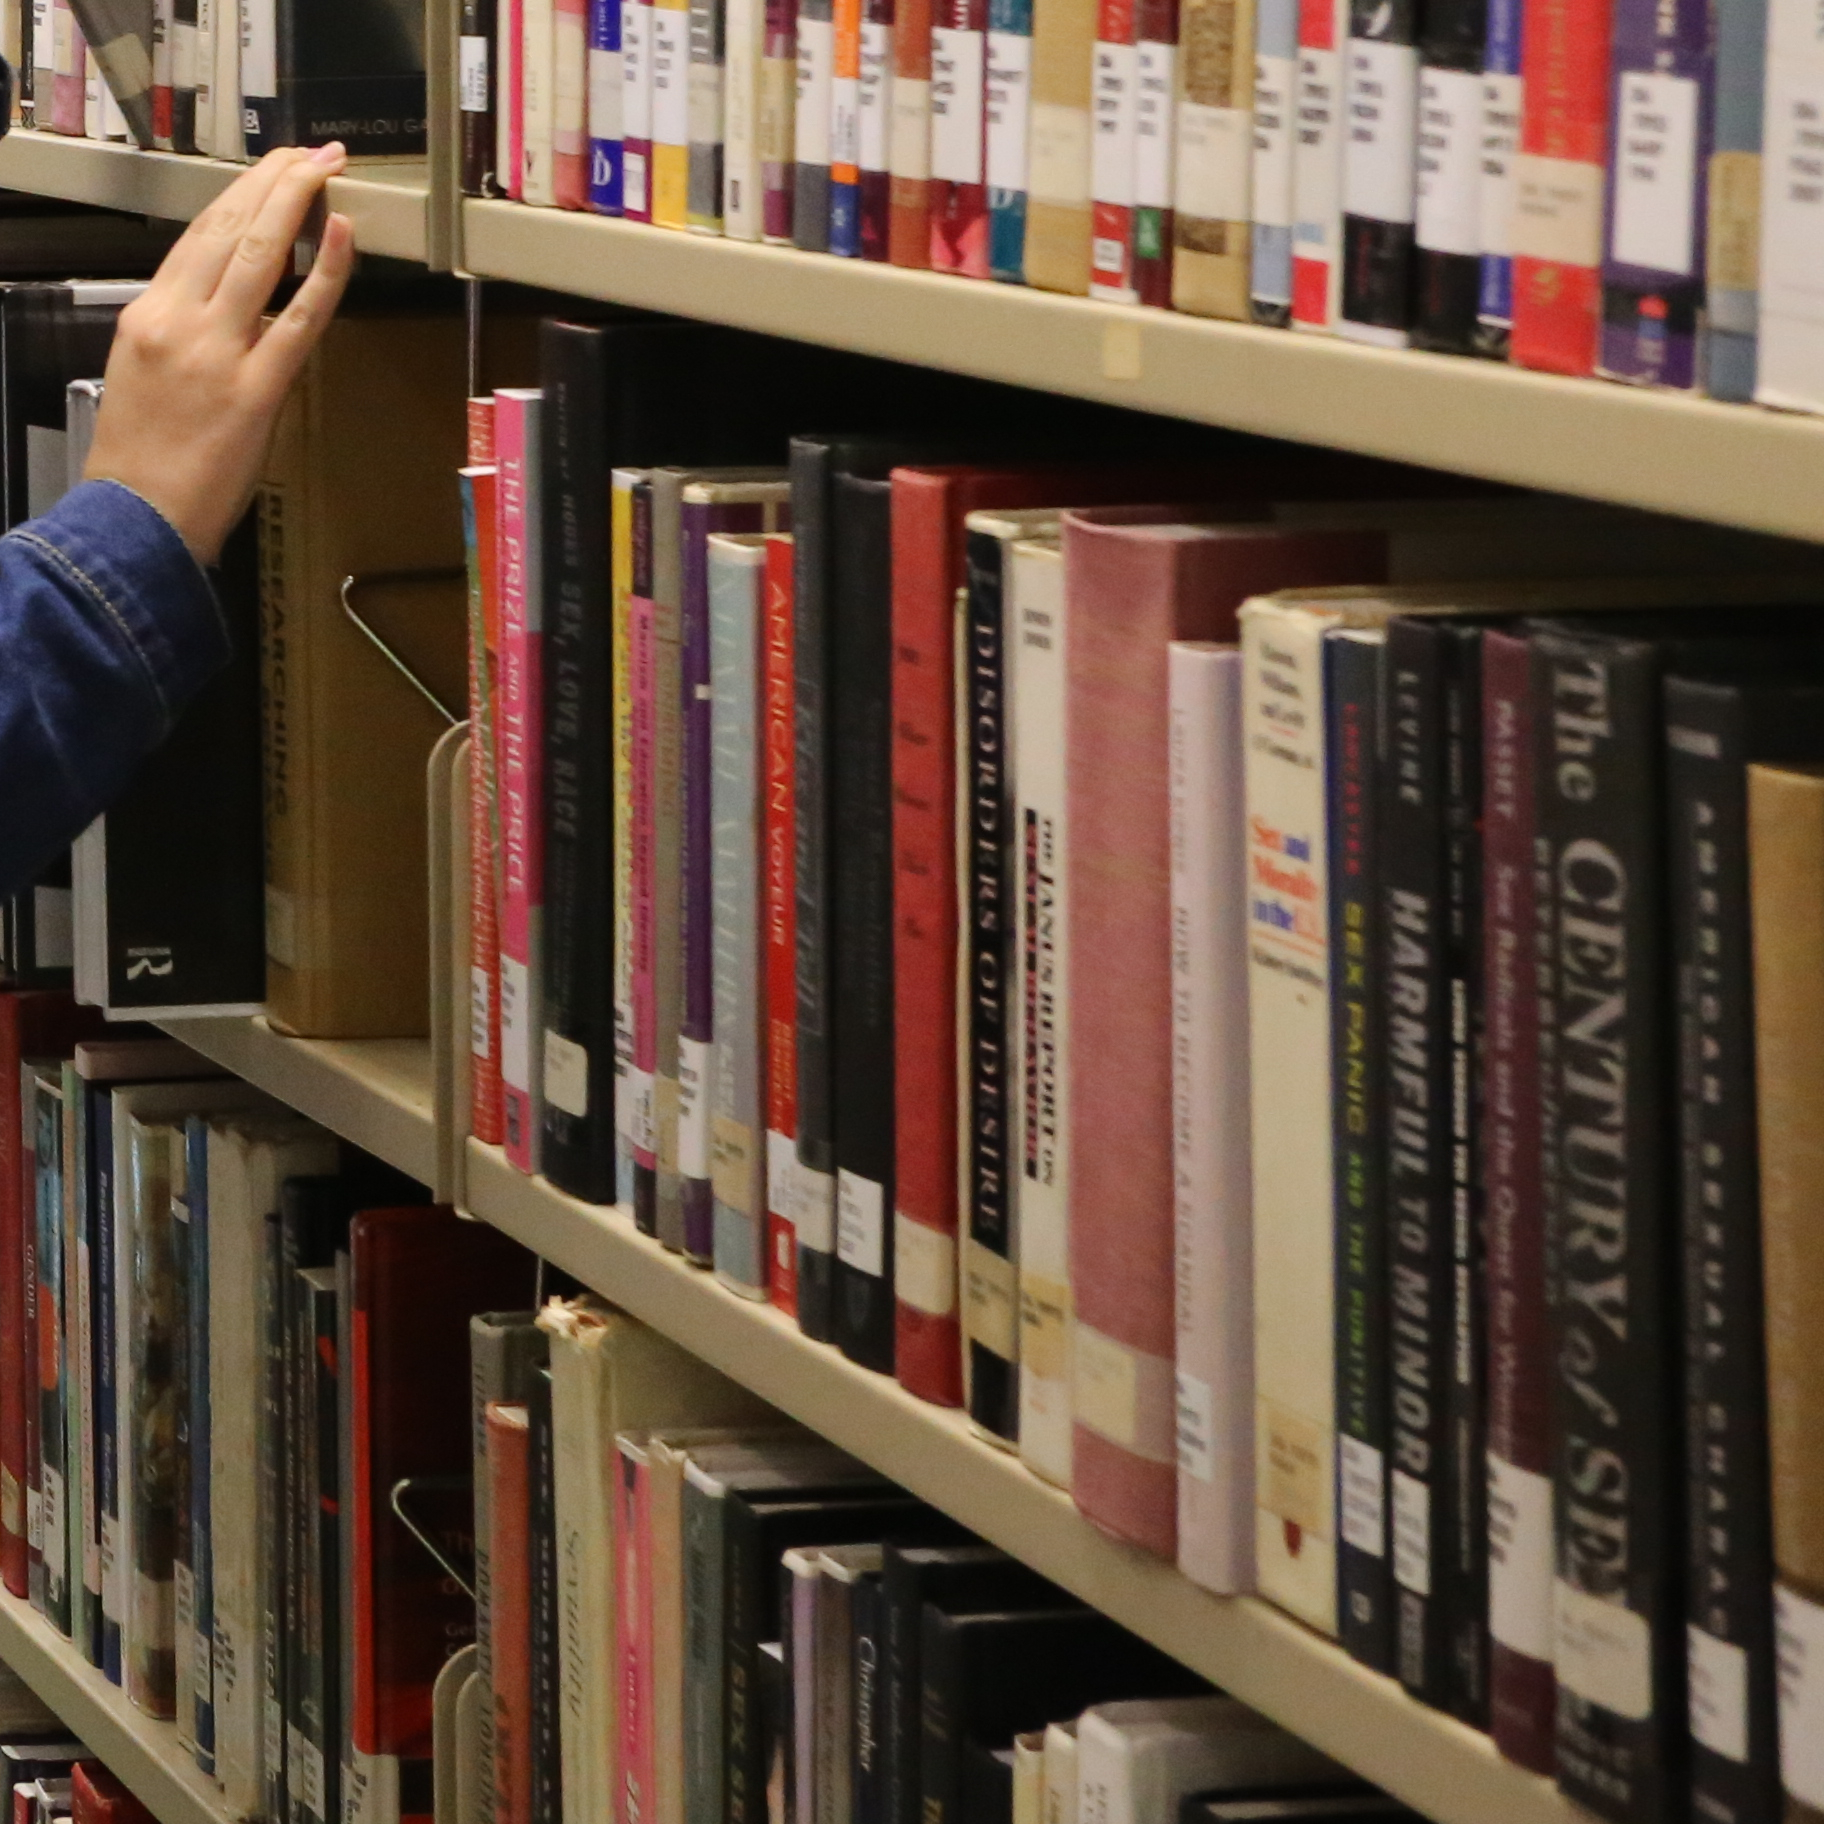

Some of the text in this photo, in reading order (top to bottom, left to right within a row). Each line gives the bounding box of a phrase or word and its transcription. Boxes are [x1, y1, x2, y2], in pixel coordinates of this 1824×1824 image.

[310, 119, 400, 138] MARY-LOU
[269, 494, 288, 816] RESEARCHING
[503, 455, 523, 893] THE PRIZE AND THE PRICE
[769, 580, 789, 946] AMERICAN VOYEUR
[554, 757, 579, 838] RACE
[975, 620, 1000, 1232] DISORDERS OF DESIRE
[1040, 991, 1057, 1138] REPORT
[1391, 670, 1430, 1473] LEVINE HARMFUL TO MINOR
[1553, 660, 1629, 1428] The CENTURY of
[25, 1243, 37, 1320] GENDER
[99, 1169, 112, 1387] Regulating sexuality
[563, 1529, 584, 1718] Sexuality
[856, 1634, 879, 1773] Christopher
